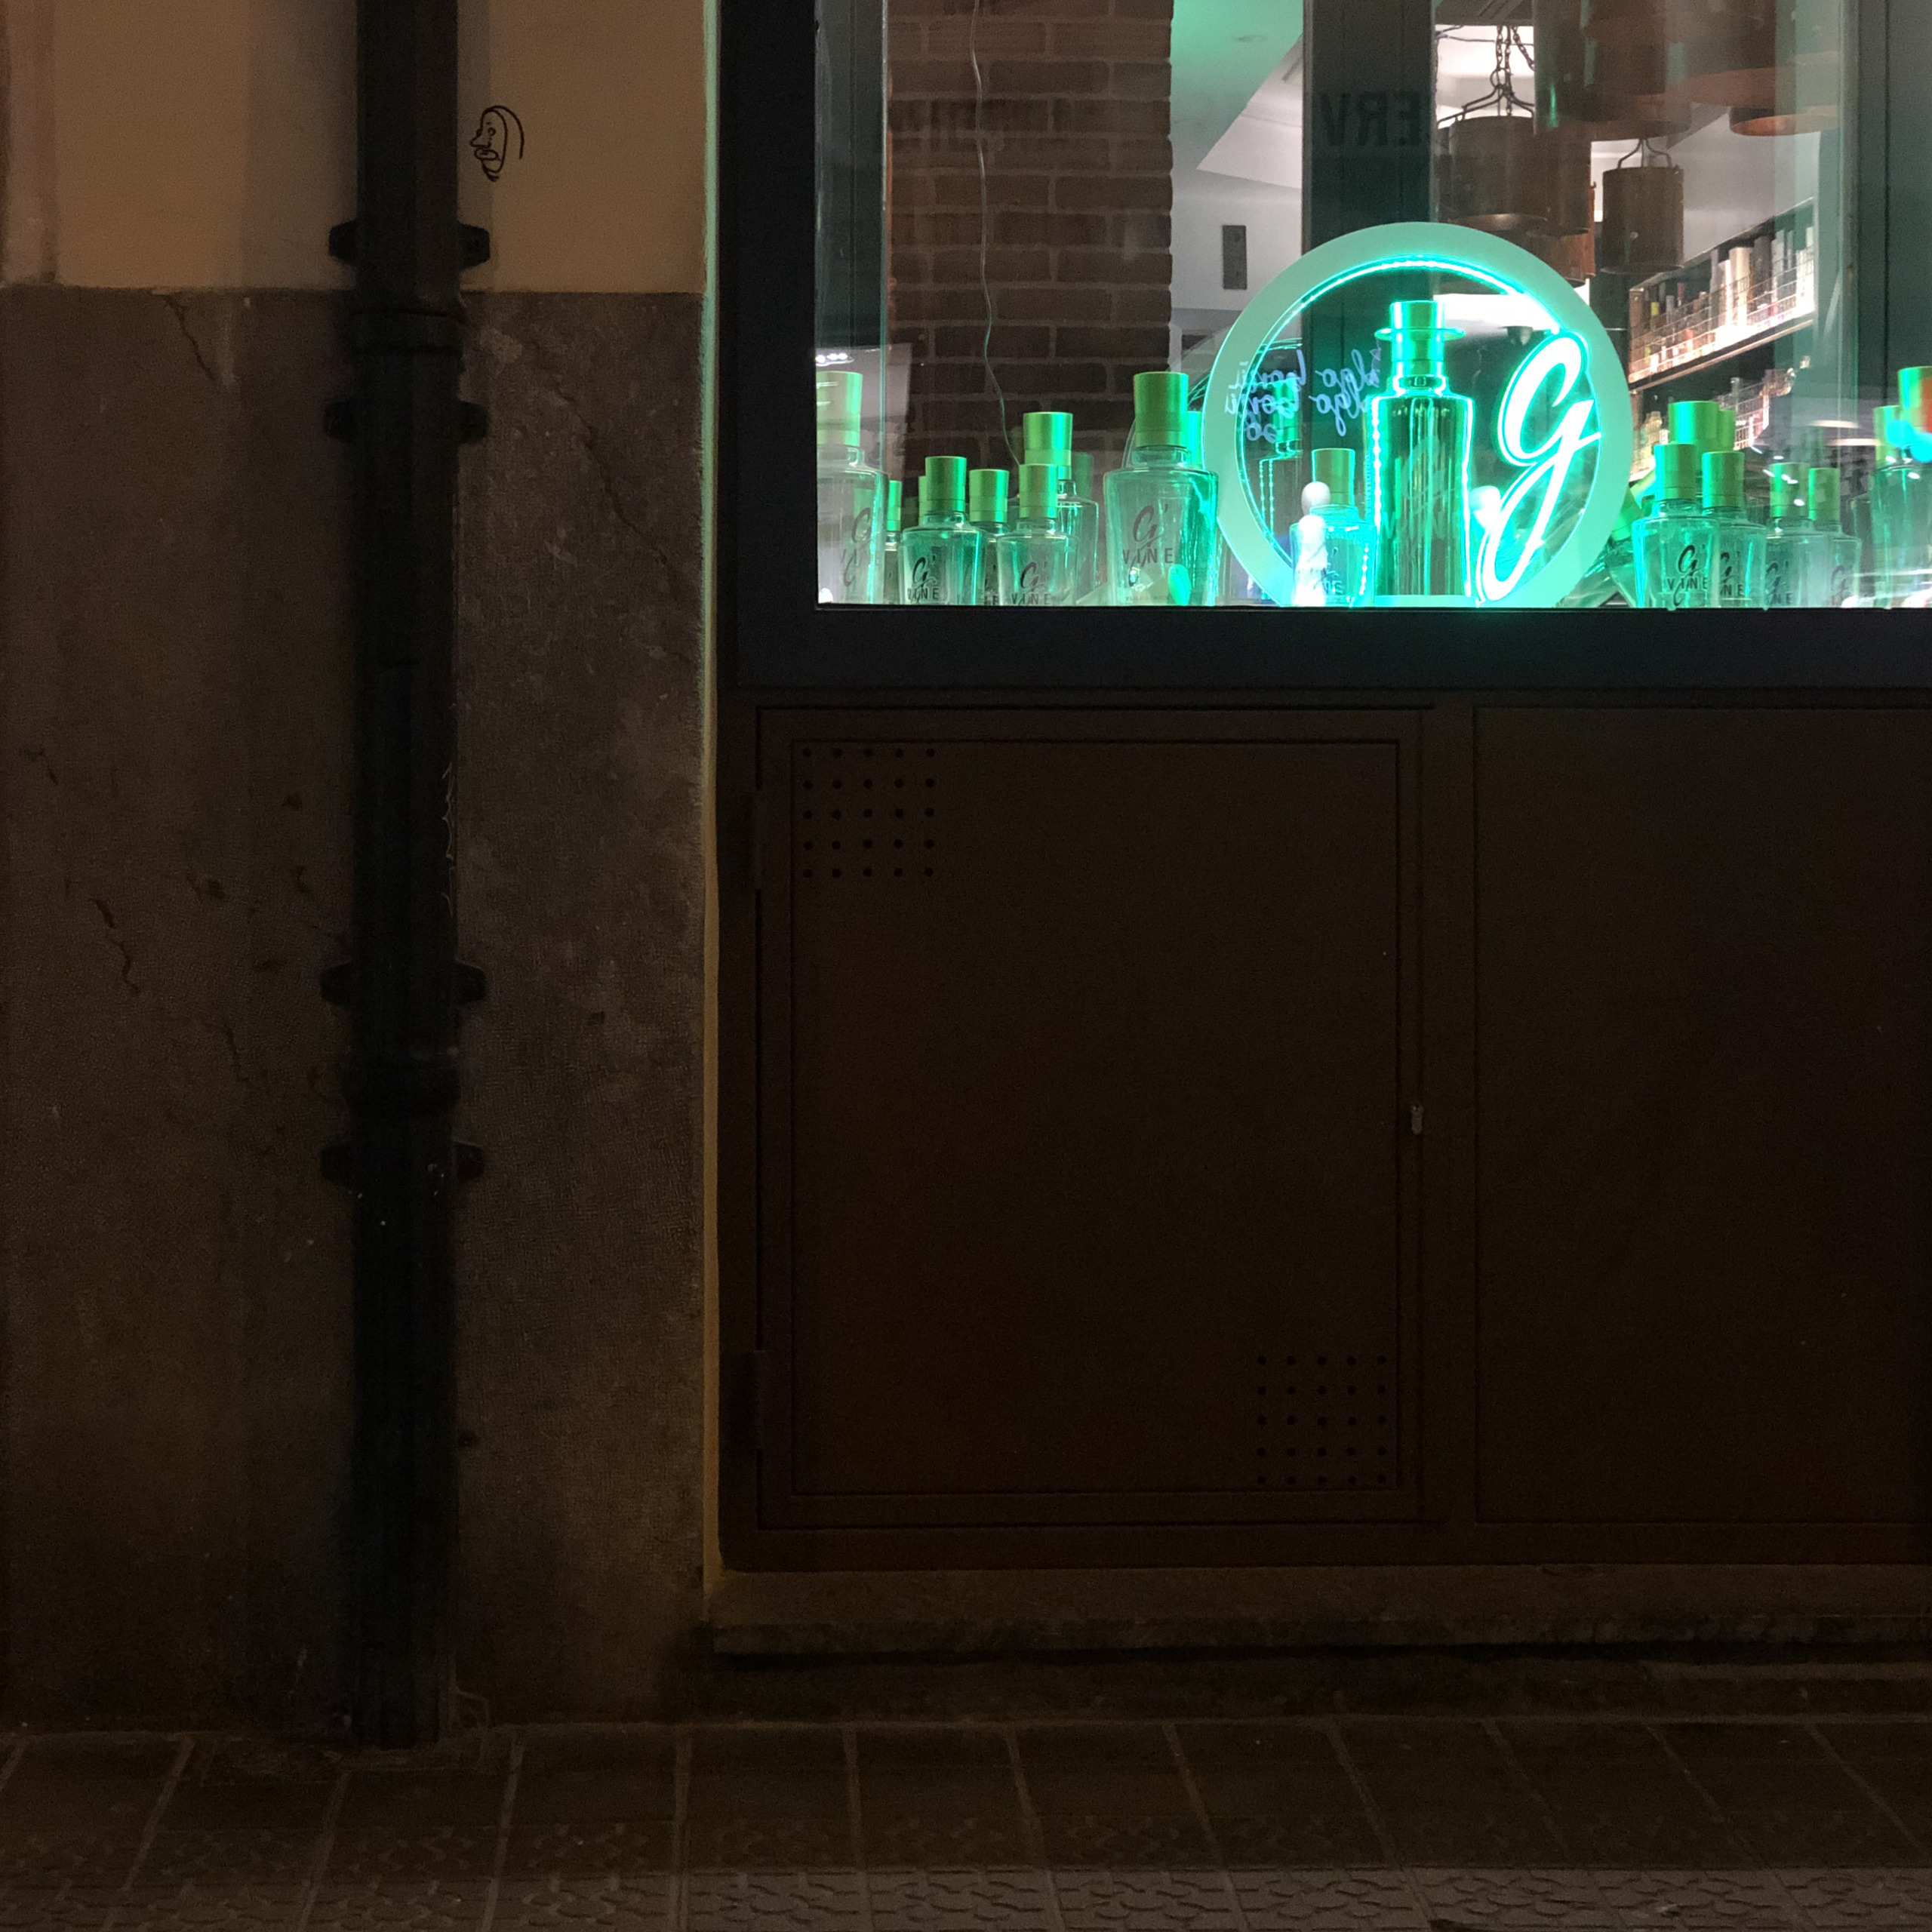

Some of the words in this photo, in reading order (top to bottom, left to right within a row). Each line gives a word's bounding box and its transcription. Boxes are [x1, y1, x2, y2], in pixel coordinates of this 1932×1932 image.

[1123, 548, 1174, 565] VINE
[1667, 577, 1708, 590] VINE
[1011, 593, 1051, 605] VINE
